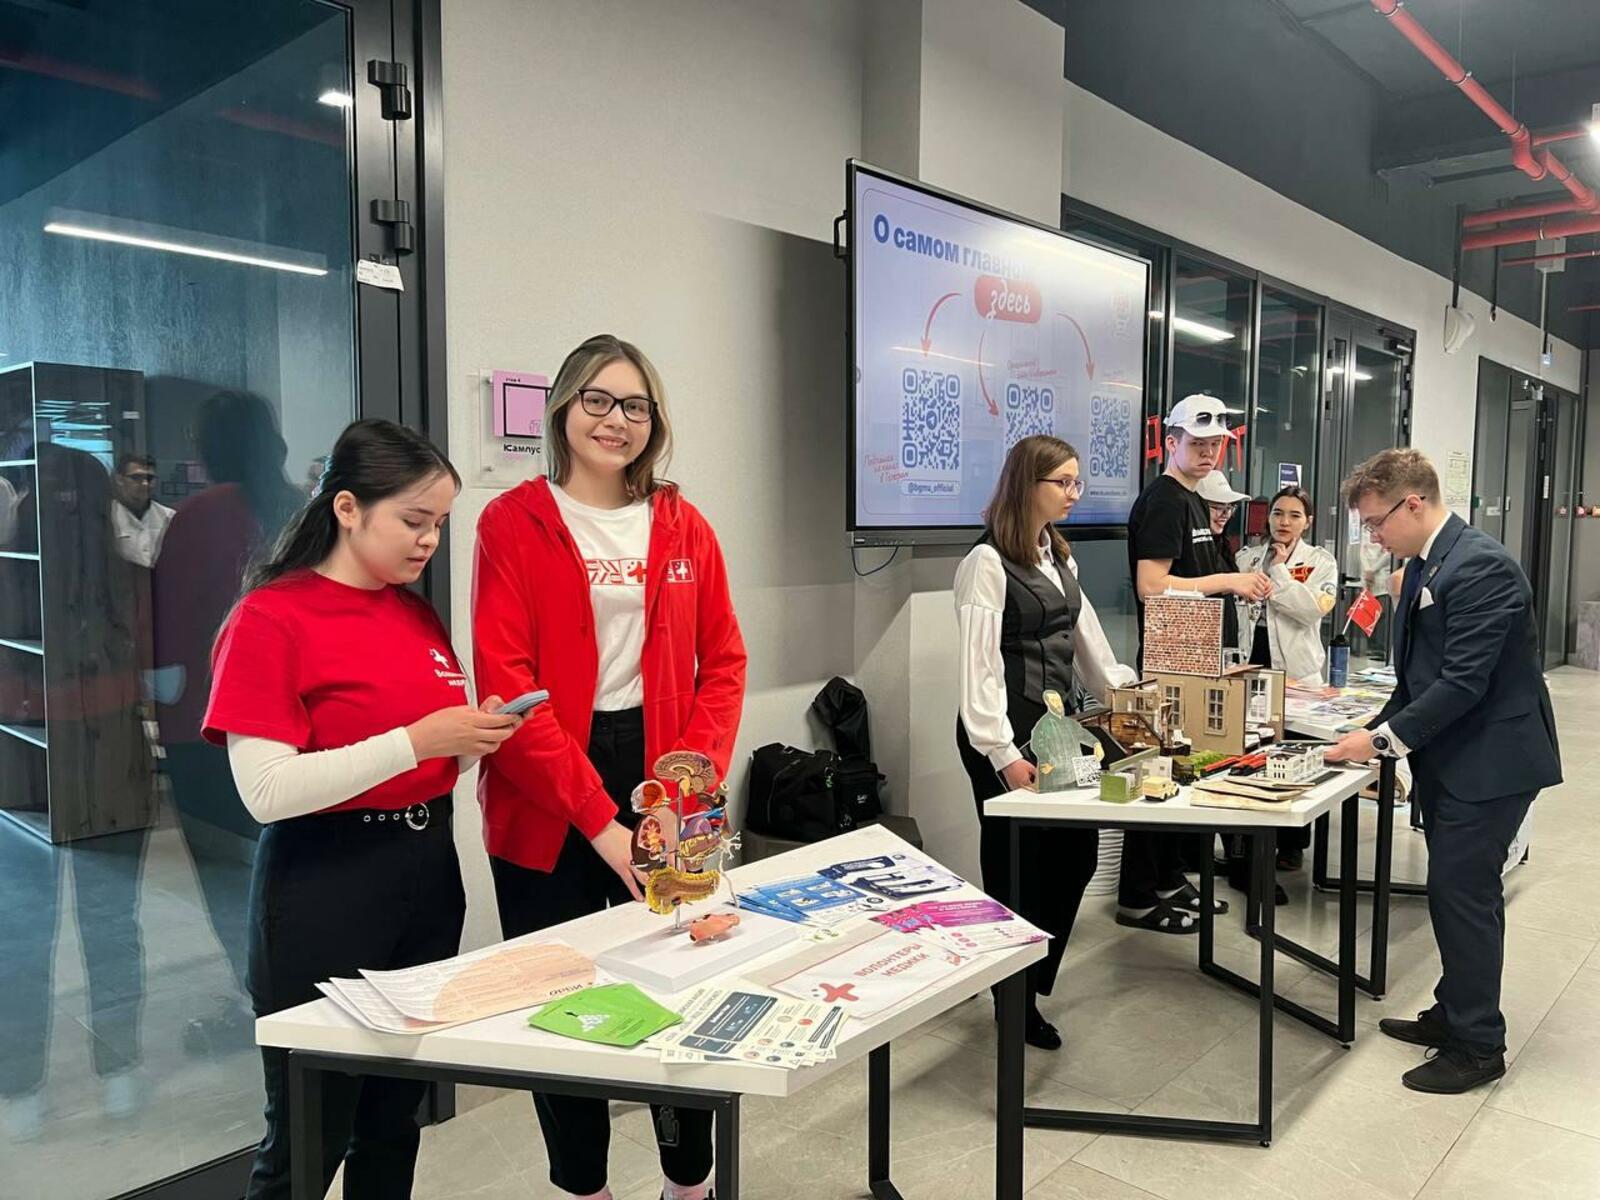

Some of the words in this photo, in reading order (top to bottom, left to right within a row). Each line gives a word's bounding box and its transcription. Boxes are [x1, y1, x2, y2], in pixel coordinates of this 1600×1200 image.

[873, 214, 890, 243] О
[893, 227, 959, 264] самом
[986, 278, 1031, 320] здесь
